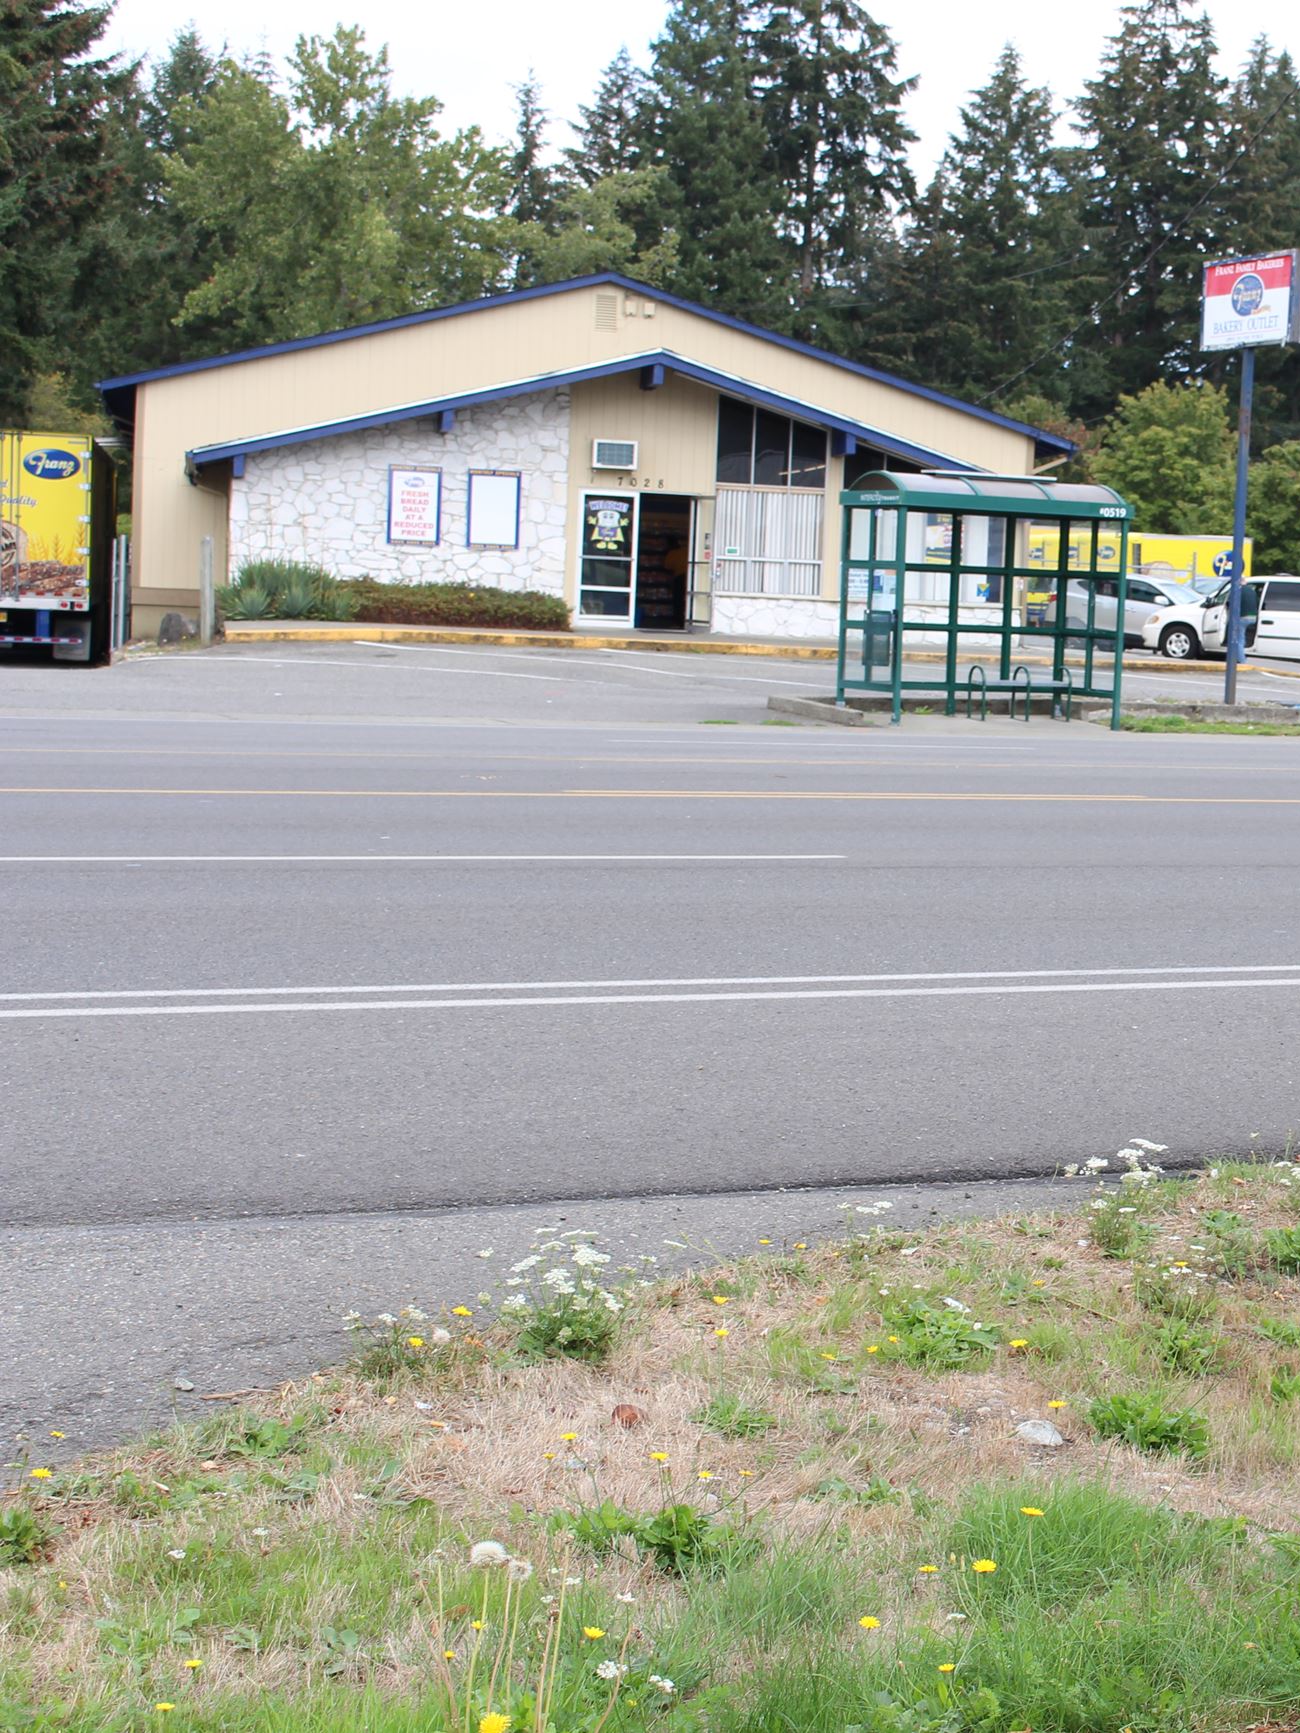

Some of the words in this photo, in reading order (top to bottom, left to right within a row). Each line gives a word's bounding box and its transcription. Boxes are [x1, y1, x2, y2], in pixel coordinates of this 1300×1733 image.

[1213, 320, 1242, 333] BAKERY
[1247, 316, 1278, 330] OUTLET
[28, 452, 75, 475] Franz
[1099, 507, 1127, 518] #0519
